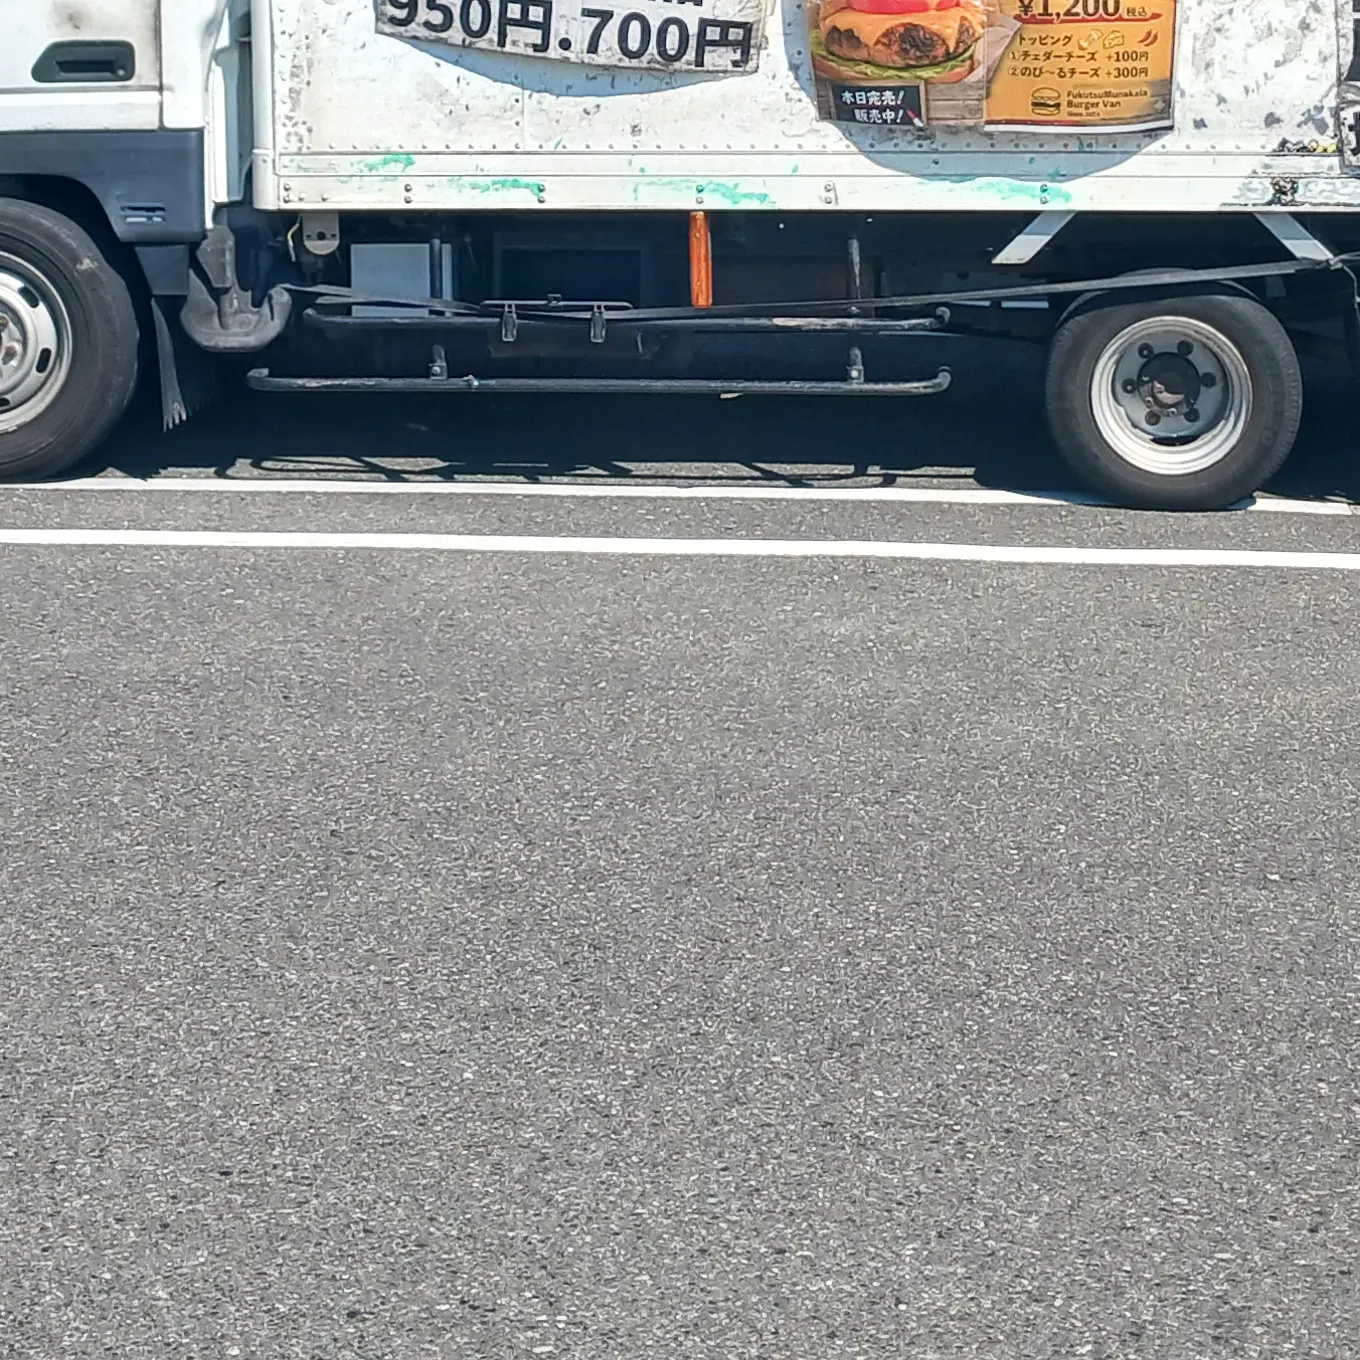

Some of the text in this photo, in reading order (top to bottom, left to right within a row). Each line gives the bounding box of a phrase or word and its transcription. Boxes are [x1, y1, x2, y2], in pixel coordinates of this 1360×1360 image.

[1018, 34, 1073, 47] トッピング
[1105, 50, 1149, 62] +100円
[1105, 66, 1149, 79] +300円
[1066, 99, 1121, 111] Burger Van
